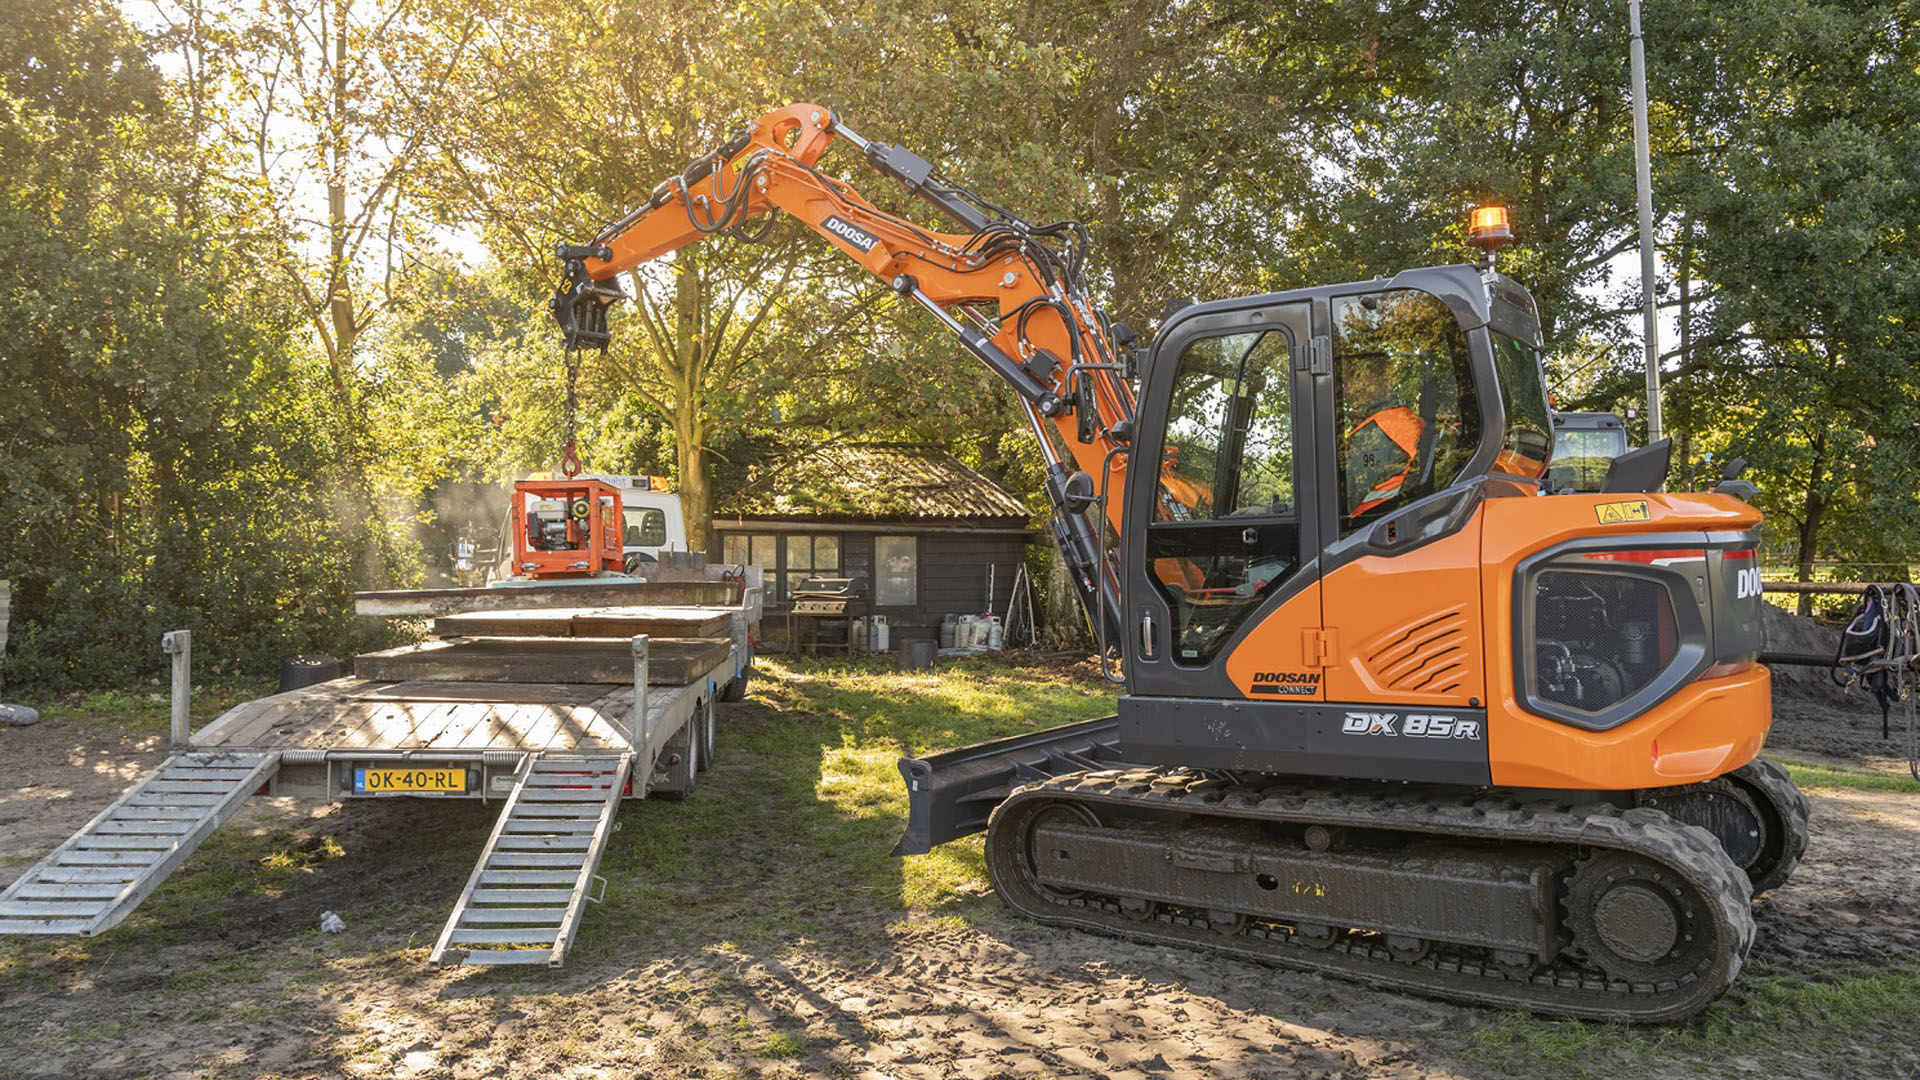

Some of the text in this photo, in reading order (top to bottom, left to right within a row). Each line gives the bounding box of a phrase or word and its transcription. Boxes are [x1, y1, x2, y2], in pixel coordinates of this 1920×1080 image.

[1253, 672, 1321, 683] DOOSAN
[1278, 686, 1315, 695] CONNECT
[1342, 712, 1480, 740] DX 85R
[369, 771, 458, 788] OK-40-RL
